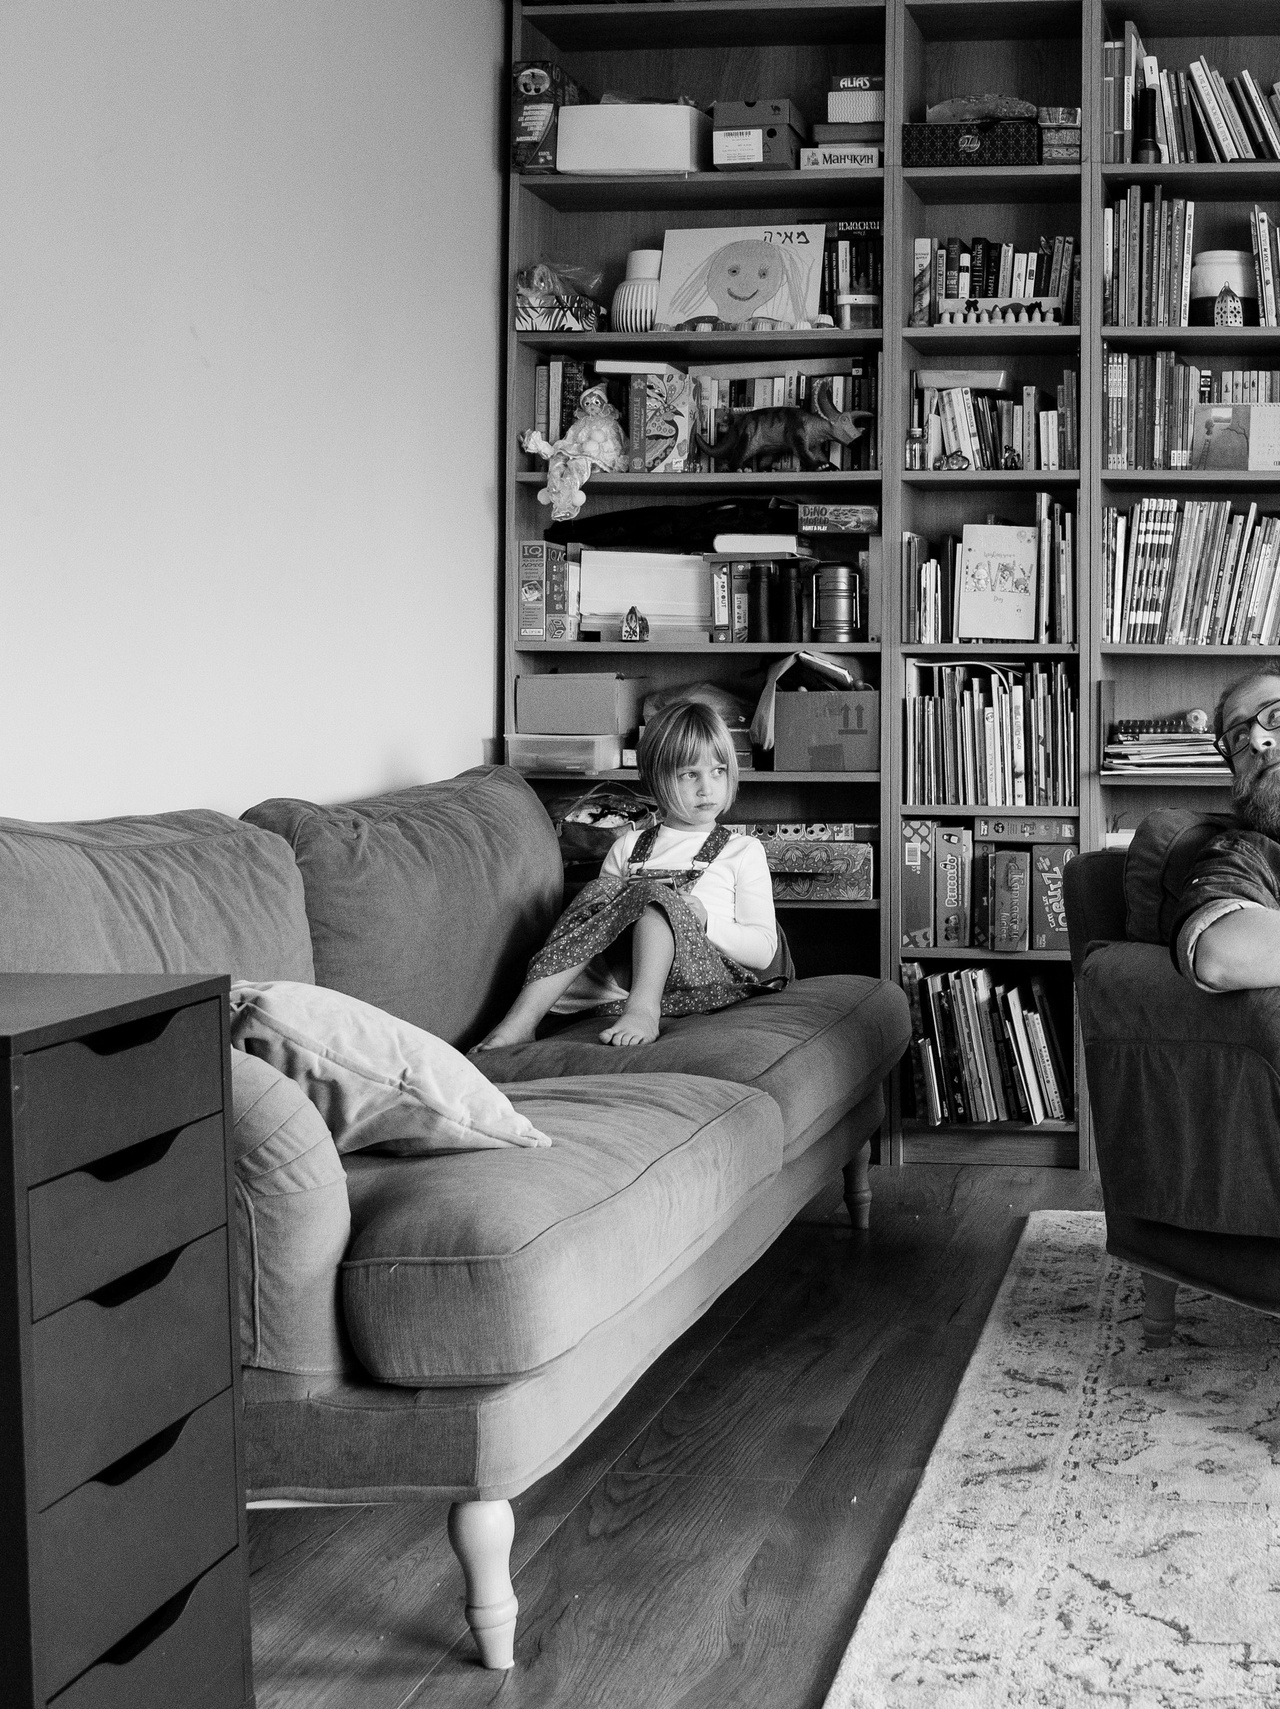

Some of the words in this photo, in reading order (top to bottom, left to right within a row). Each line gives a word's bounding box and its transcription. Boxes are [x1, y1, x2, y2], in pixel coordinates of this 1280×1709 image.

[822, 153, 874, 166] Манчкин
[763, 230, 810, 245] מאיה
[633, 397, 641, 425] PUZZLE
[523, 545, 543, 558] IQ
